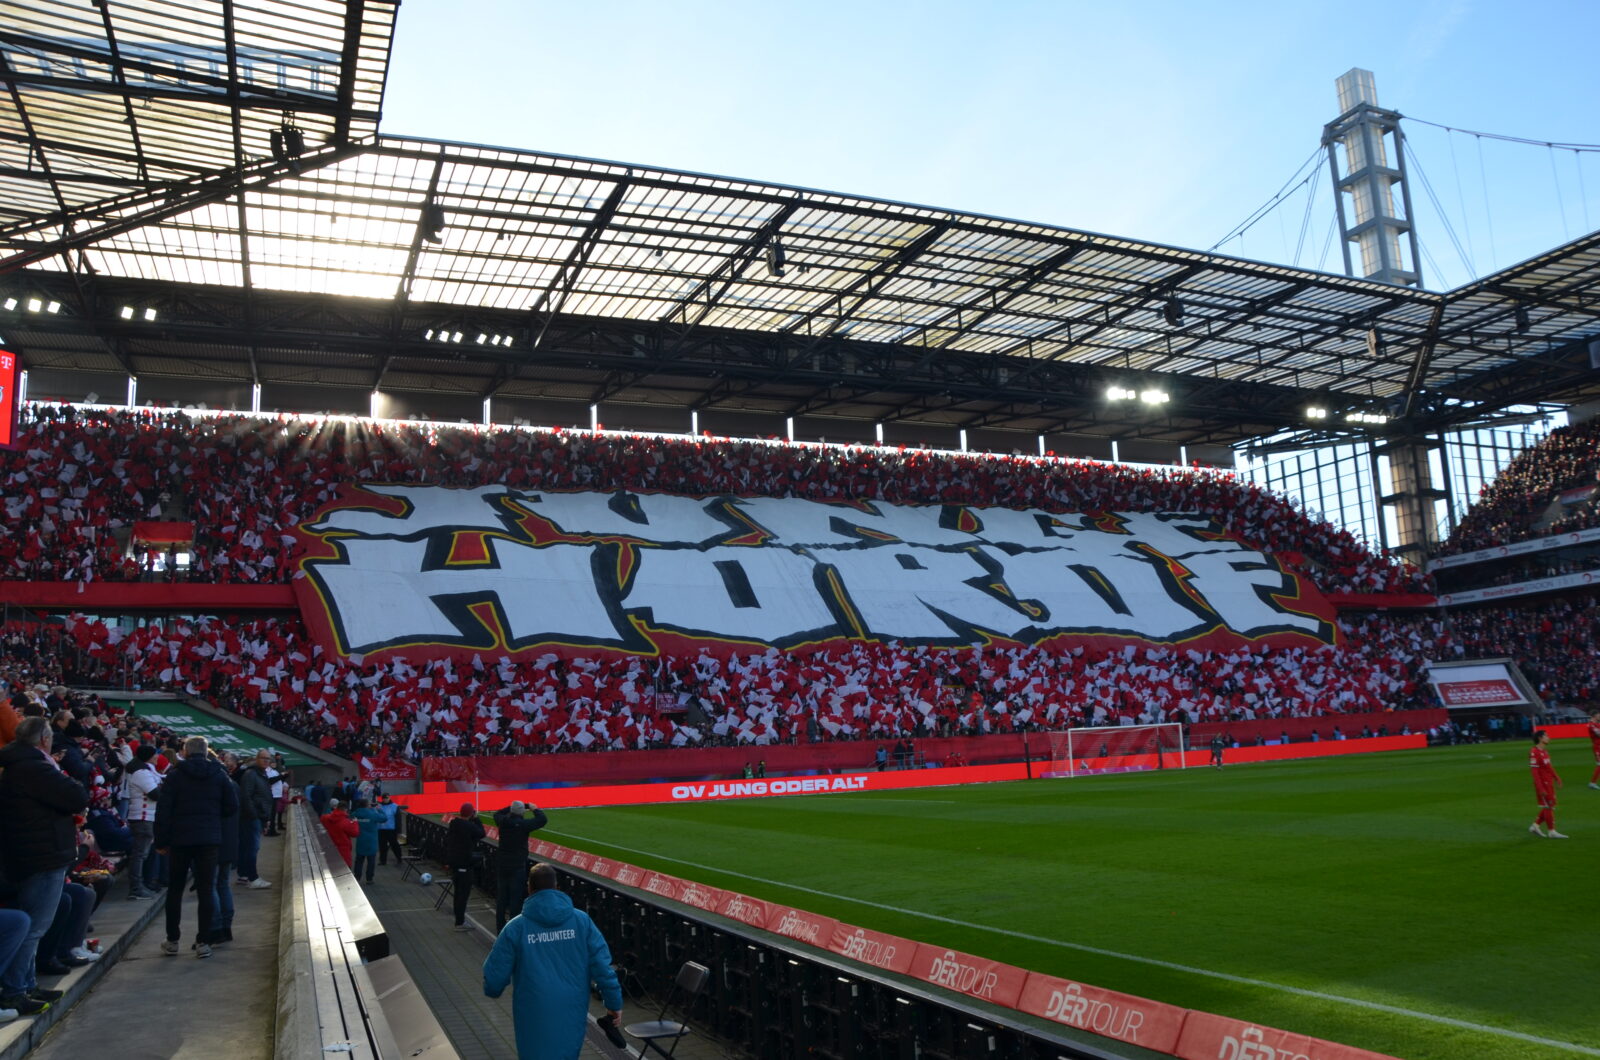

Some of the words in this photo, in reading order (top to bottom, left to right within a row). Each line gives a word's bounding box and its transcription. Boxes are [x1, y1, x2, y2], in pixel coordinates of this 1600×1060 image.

[305, 537, 1336, 654] HORDE
[671, 785, 706, 798] OV
[708, 782, 767, 797] JUNG
[770, 778, 831, 794] ODER
[831, 776, 868, 789] ALT
[527, 929, 575, 944] FC-VOLUNTEER
[778, 914, 819, 944] DERTOUR
[843, 934, 896, 969] DERTOUR
[928, 956, 998, 998] DERTOUR
[1045, 989, 1144, 1042] DERTOUR
